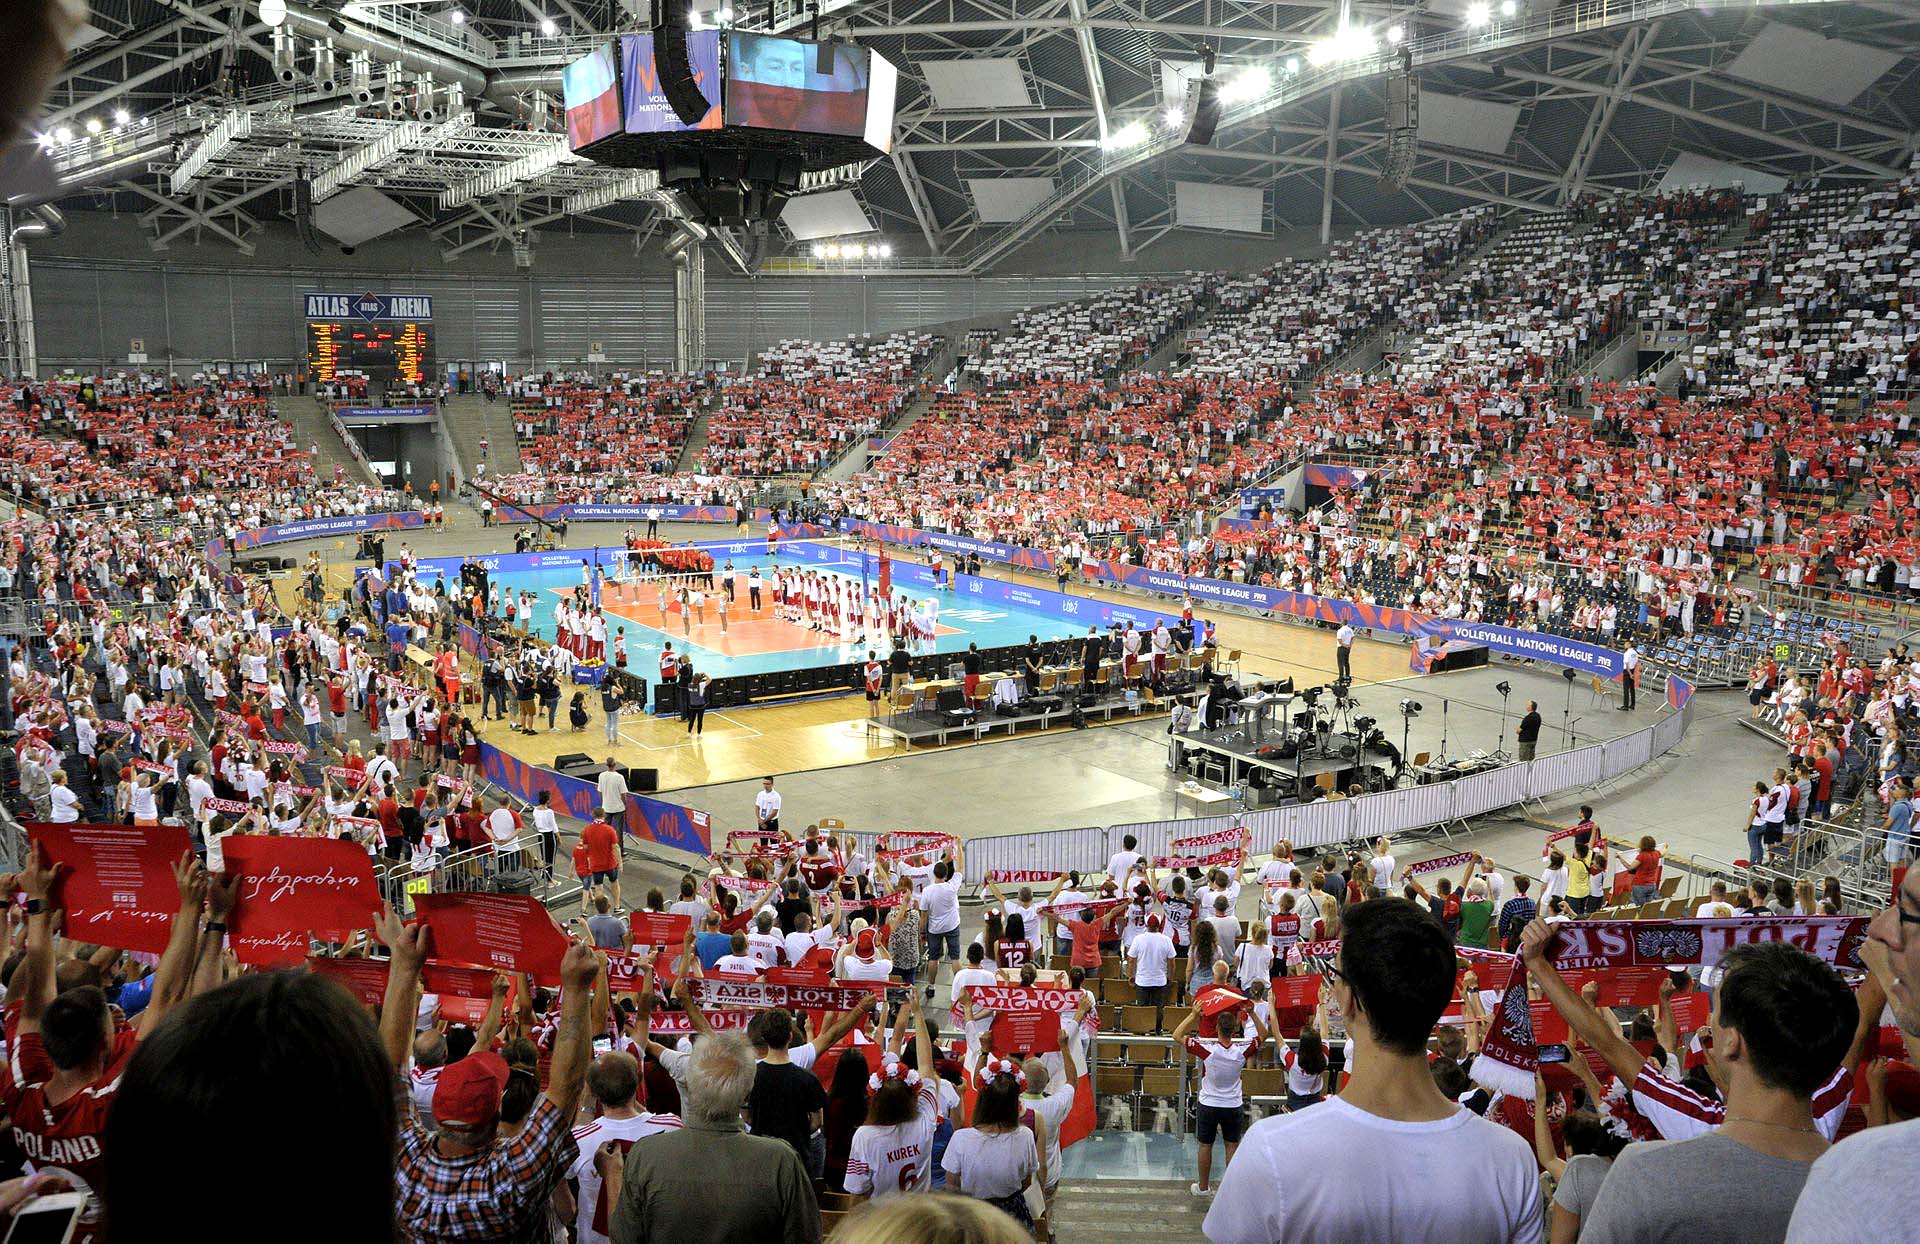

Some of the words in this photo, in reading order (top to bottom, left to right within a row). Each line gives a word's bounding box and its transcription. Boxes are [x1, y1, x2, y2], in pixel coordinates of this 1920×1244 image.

[648, 95, 668, 103] VOLL
[307, 296, 349, 316] ATLAS
[390, 297, 431, 317] ARENA
[360, 302, 378, 312] ATLAS
[573, 507, 611, 515] VOLLEYBALL
[277, 525, 305, 536] VOLLEYBALL
[305, 522, 329, 532] NATIONS
[330, 520, 353, 528] LEAGUE
[930, 537, 957, 548] VOLLEYBALL
[957, 541, 978, 551] NATIONS
[977, 544, 995, 554] LEAGUE
[483, 558, 499, 570] ÓDŹ
[1149, 576, 1188, 590] VOLLEYBALL
[1189, 583, 1220, 595] NATIONS
[1222, 587, 1250, 599] LEAGUE
[1455, 627, 1513, 646] VOLLEYBALL
[1516, 637, 1558, 654] NATIONS
[1560, 646, 1594, 664] LEAGUE
[1775, 645, 1789, 656] PG
[208, 797, 250, 814] OLSKA
[808, 870, 816, 884] 2
[1169, 910, 1181, 922] 16
[1303, 940, 1341, 955] POLS
[1558, 927, 1628, 957] SK
[1005, 951, 1025, 968] 12
[1555, 956, 1610, 970] WIER
[1485, 1043, 1539, 1069] POLSKA
[12, 1126, 101, 1164] POLAND
[886, 1143, 921, 1164] KUREK
[898, 1162, 920, 1192] 6
